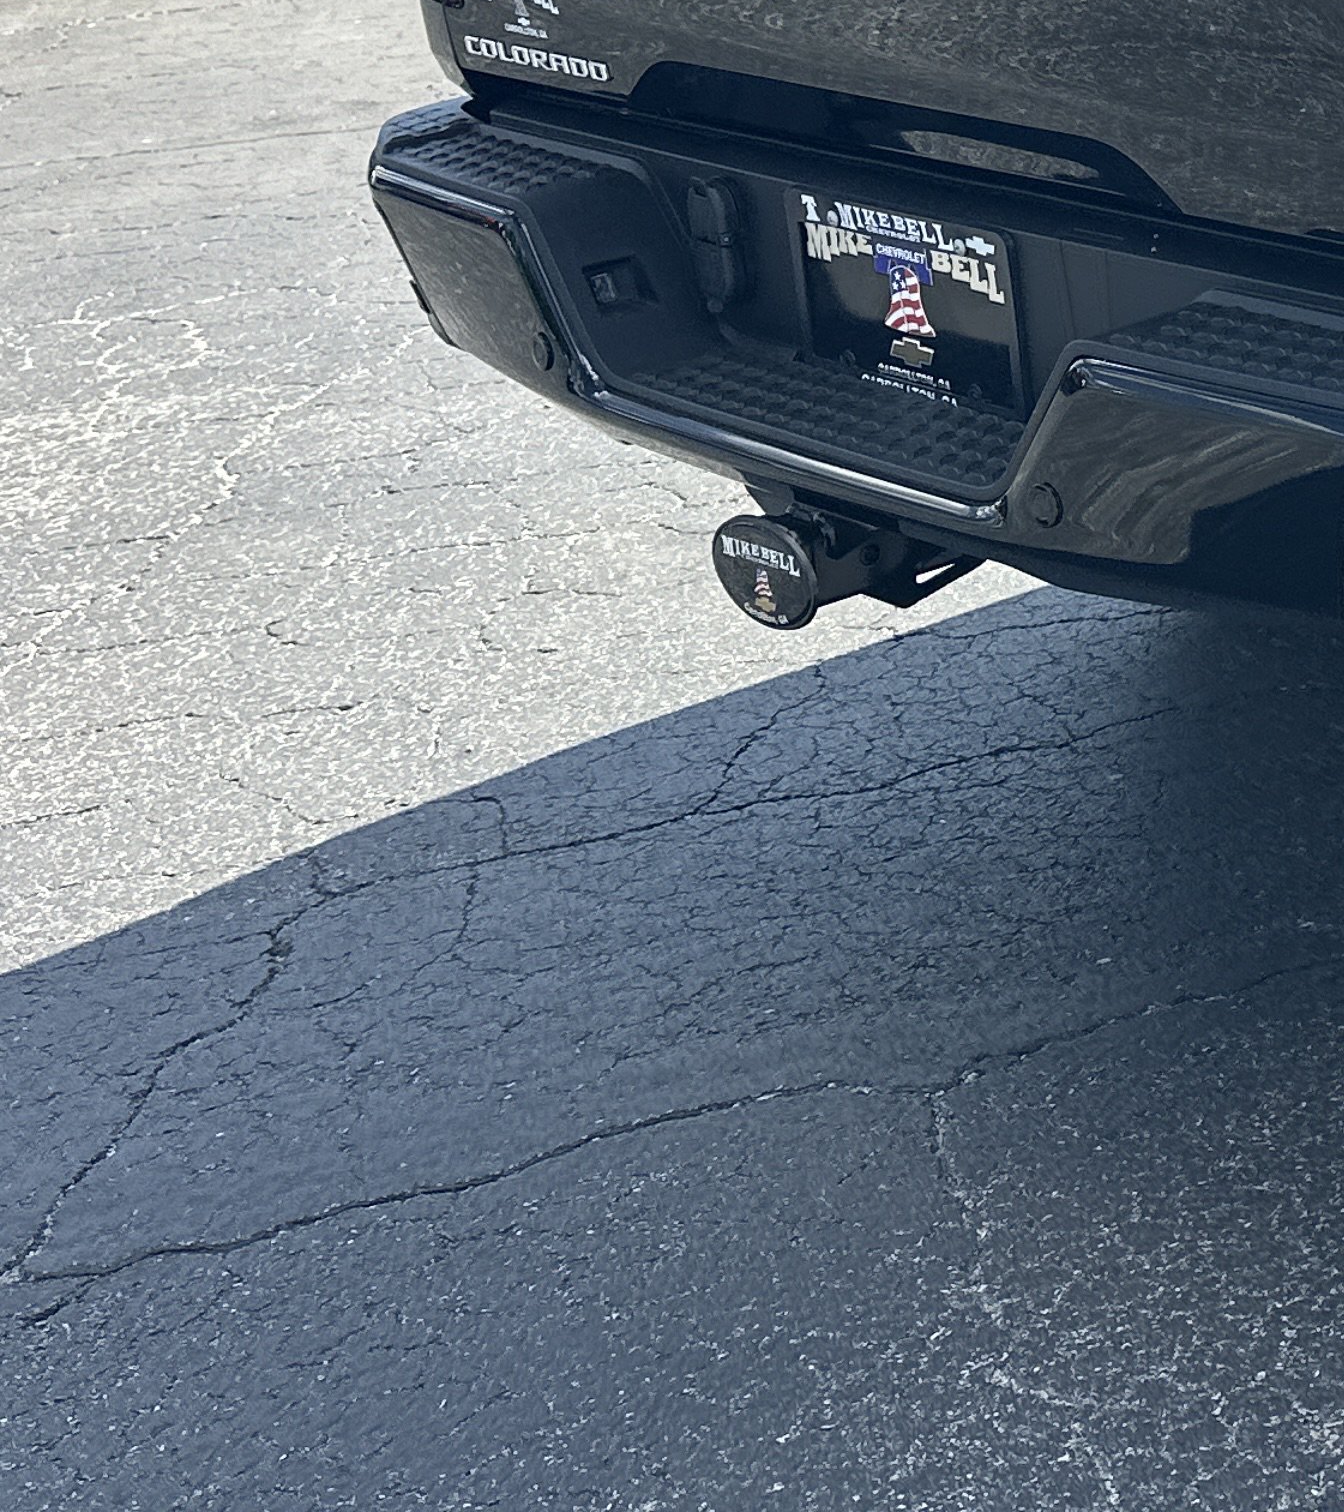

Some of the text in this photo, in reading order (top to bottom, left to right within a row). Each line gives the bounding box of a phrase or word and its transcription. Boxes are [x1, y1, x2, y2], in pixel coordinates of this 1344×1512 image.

[463, 35, 610, 82] COLORADO
[834, 201, 891, 231] MIKE
[891, 214, 955, 252] BELL
[805, 222, 1006, 305] MIKE BELL
[876, 243, 927, 265] CHEVROLET
[721, 534, 761, 558] MIKE
[760, 546, 801, 578] BELL
